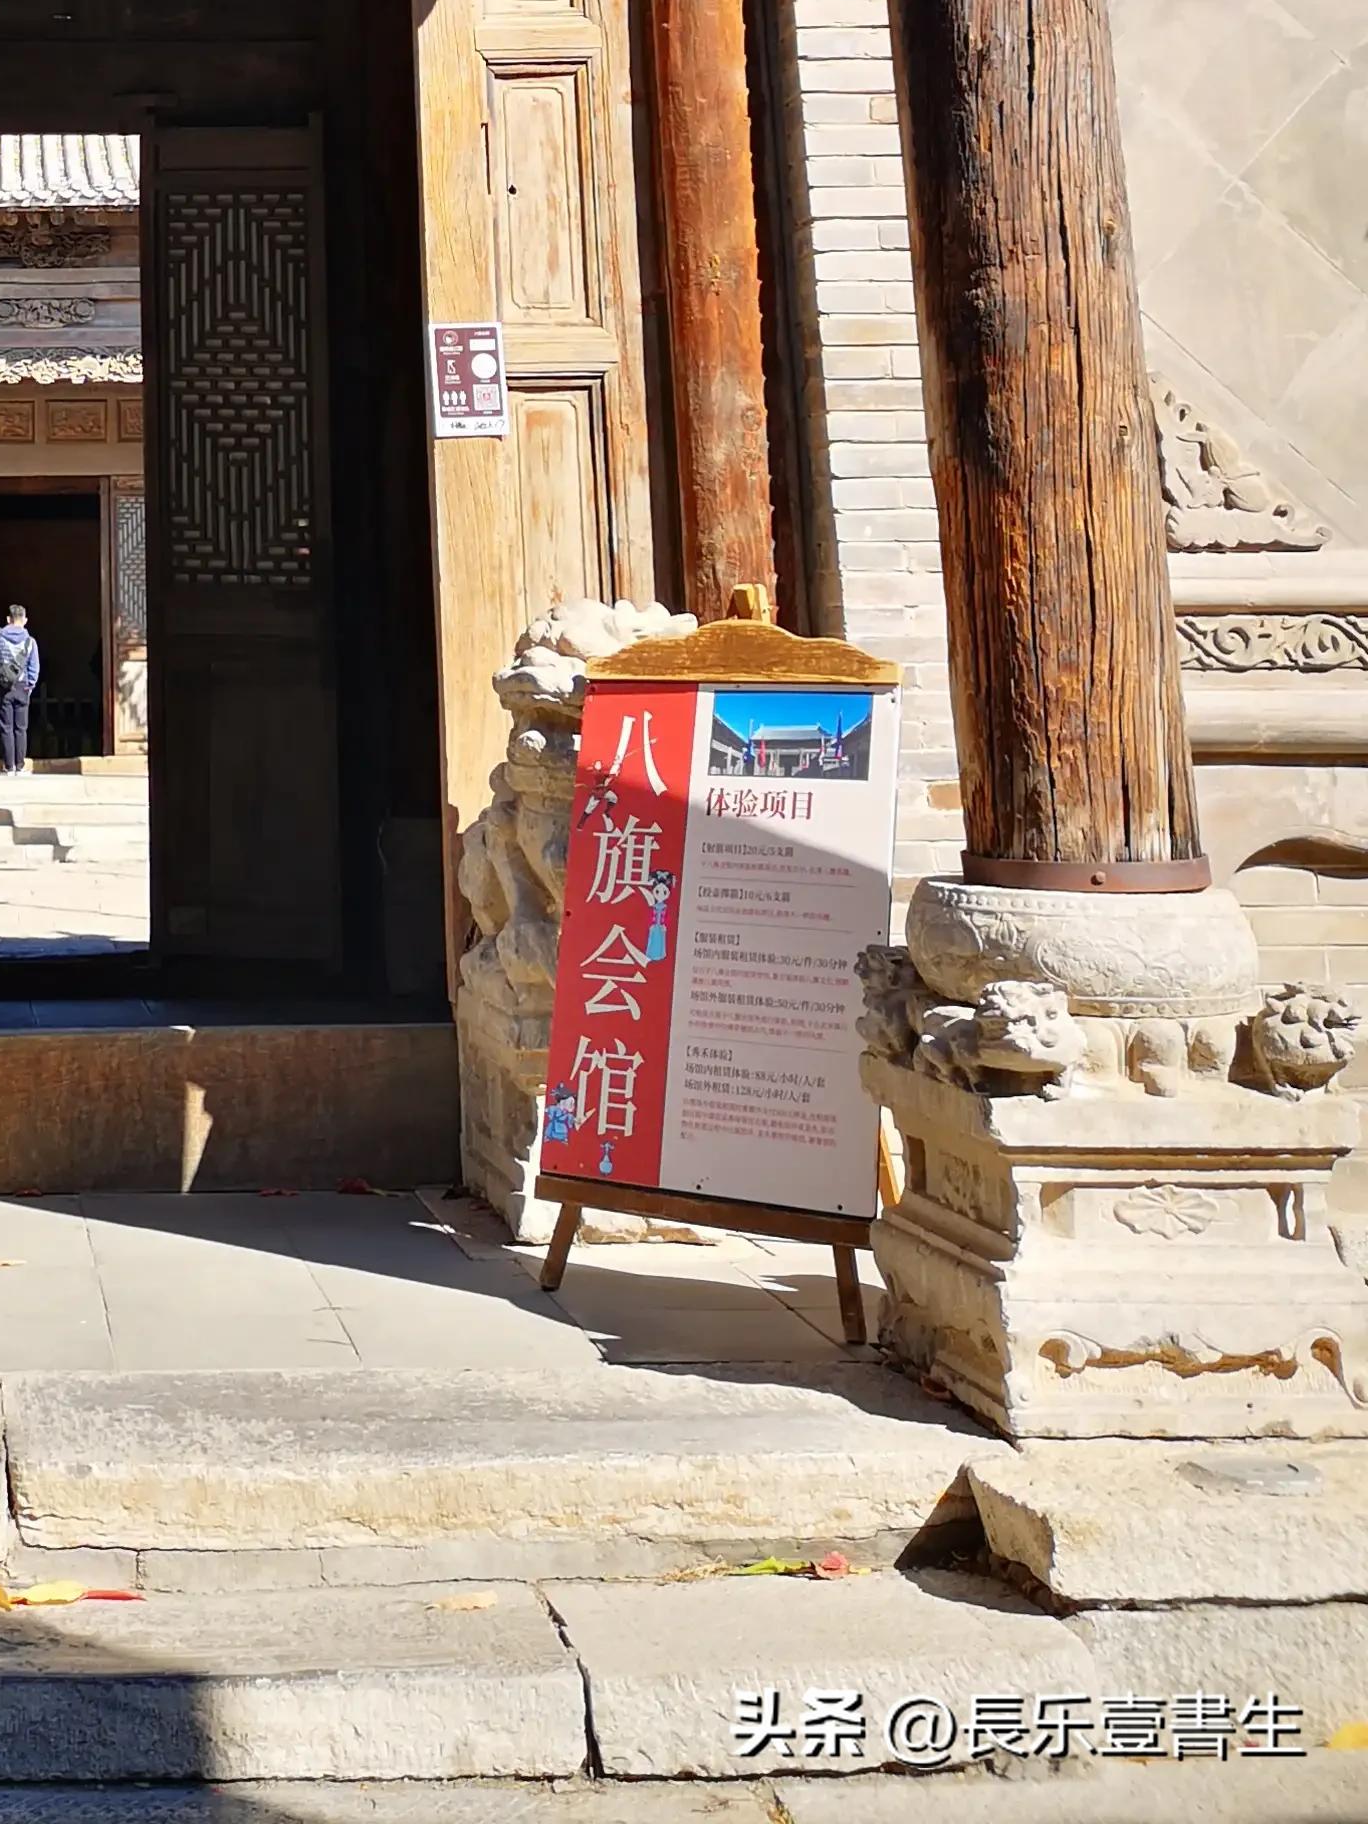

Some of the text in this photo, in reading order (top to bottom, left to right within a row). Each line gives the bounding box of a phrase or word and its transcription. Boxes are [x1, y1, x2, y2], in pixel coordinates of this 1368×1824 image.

[705, 787, 814, 821] 体验项目
[567, 709, 669, 1139] 八旗会馆
